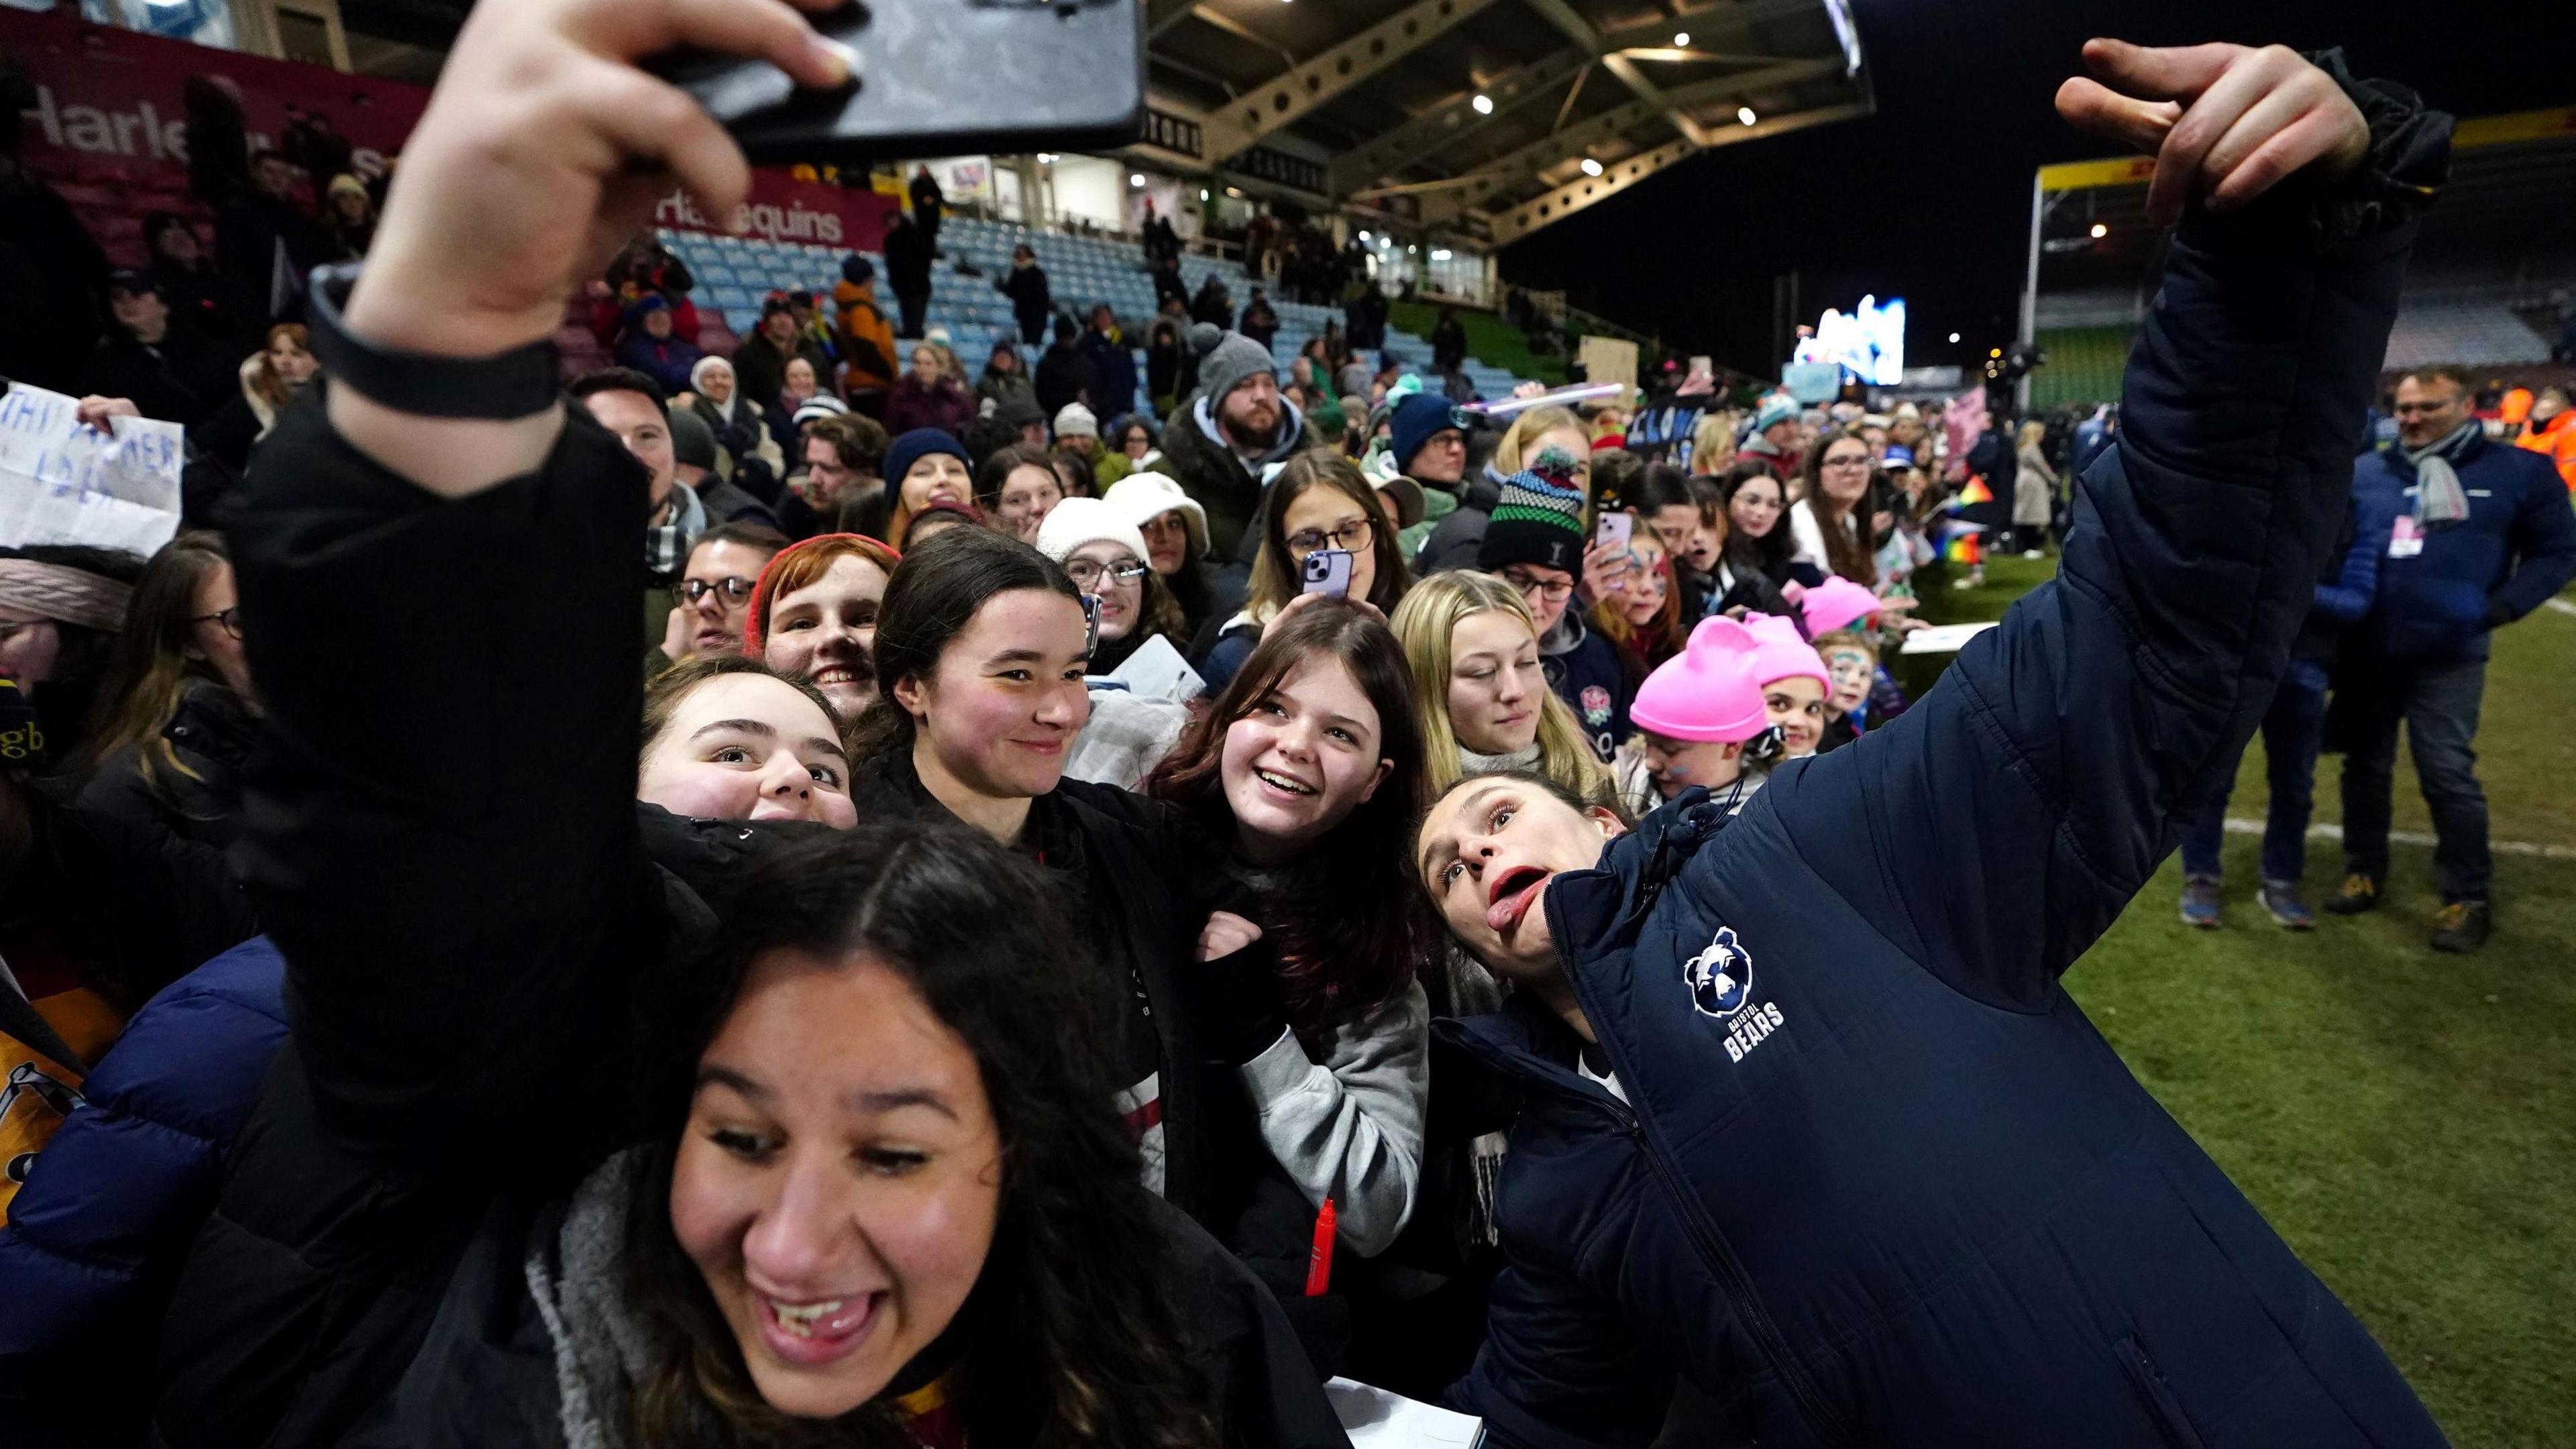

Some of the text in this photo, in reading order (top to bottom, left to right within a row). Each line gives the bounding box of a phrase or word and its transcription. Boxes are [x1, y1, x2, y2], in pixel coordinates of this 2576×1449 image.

[19, 85, 384, 182] Harles
[655, 189, 843, 242] Haequins
[1723, 1002, 1784, 1063] BEARS
[1727, 1003, 1760, 1032] BRISTOL
